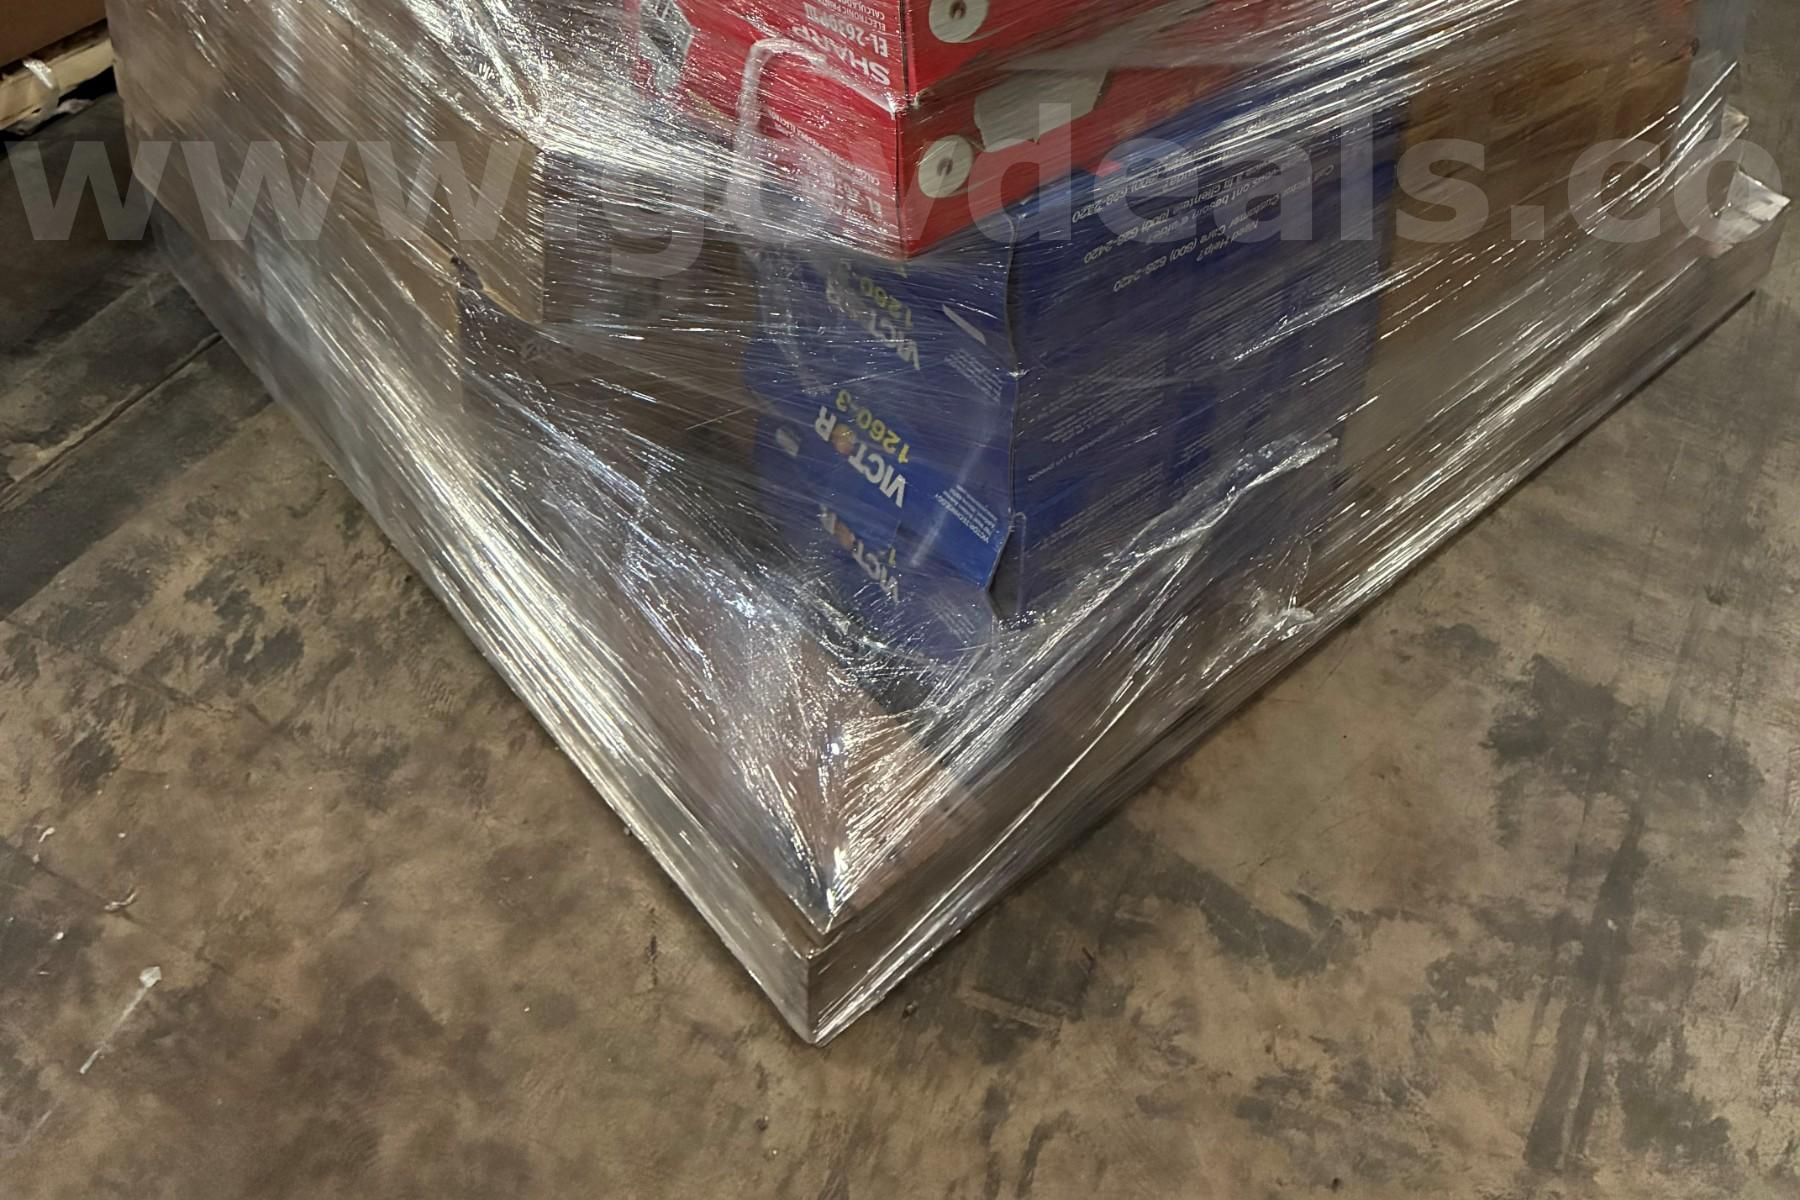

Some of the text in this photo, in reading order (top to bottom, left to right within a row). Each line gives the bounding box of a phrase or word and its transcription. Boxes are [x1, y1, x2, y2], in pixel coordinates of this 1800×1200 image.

[792, 25, 890, 85] SHARP
[1197, 236, 1230, 262] Help?
[1200, 224, 1226, 243] Care
[835, 389, 910, 463] 1260-3
[814, 405, 907, 508] VICTOR
